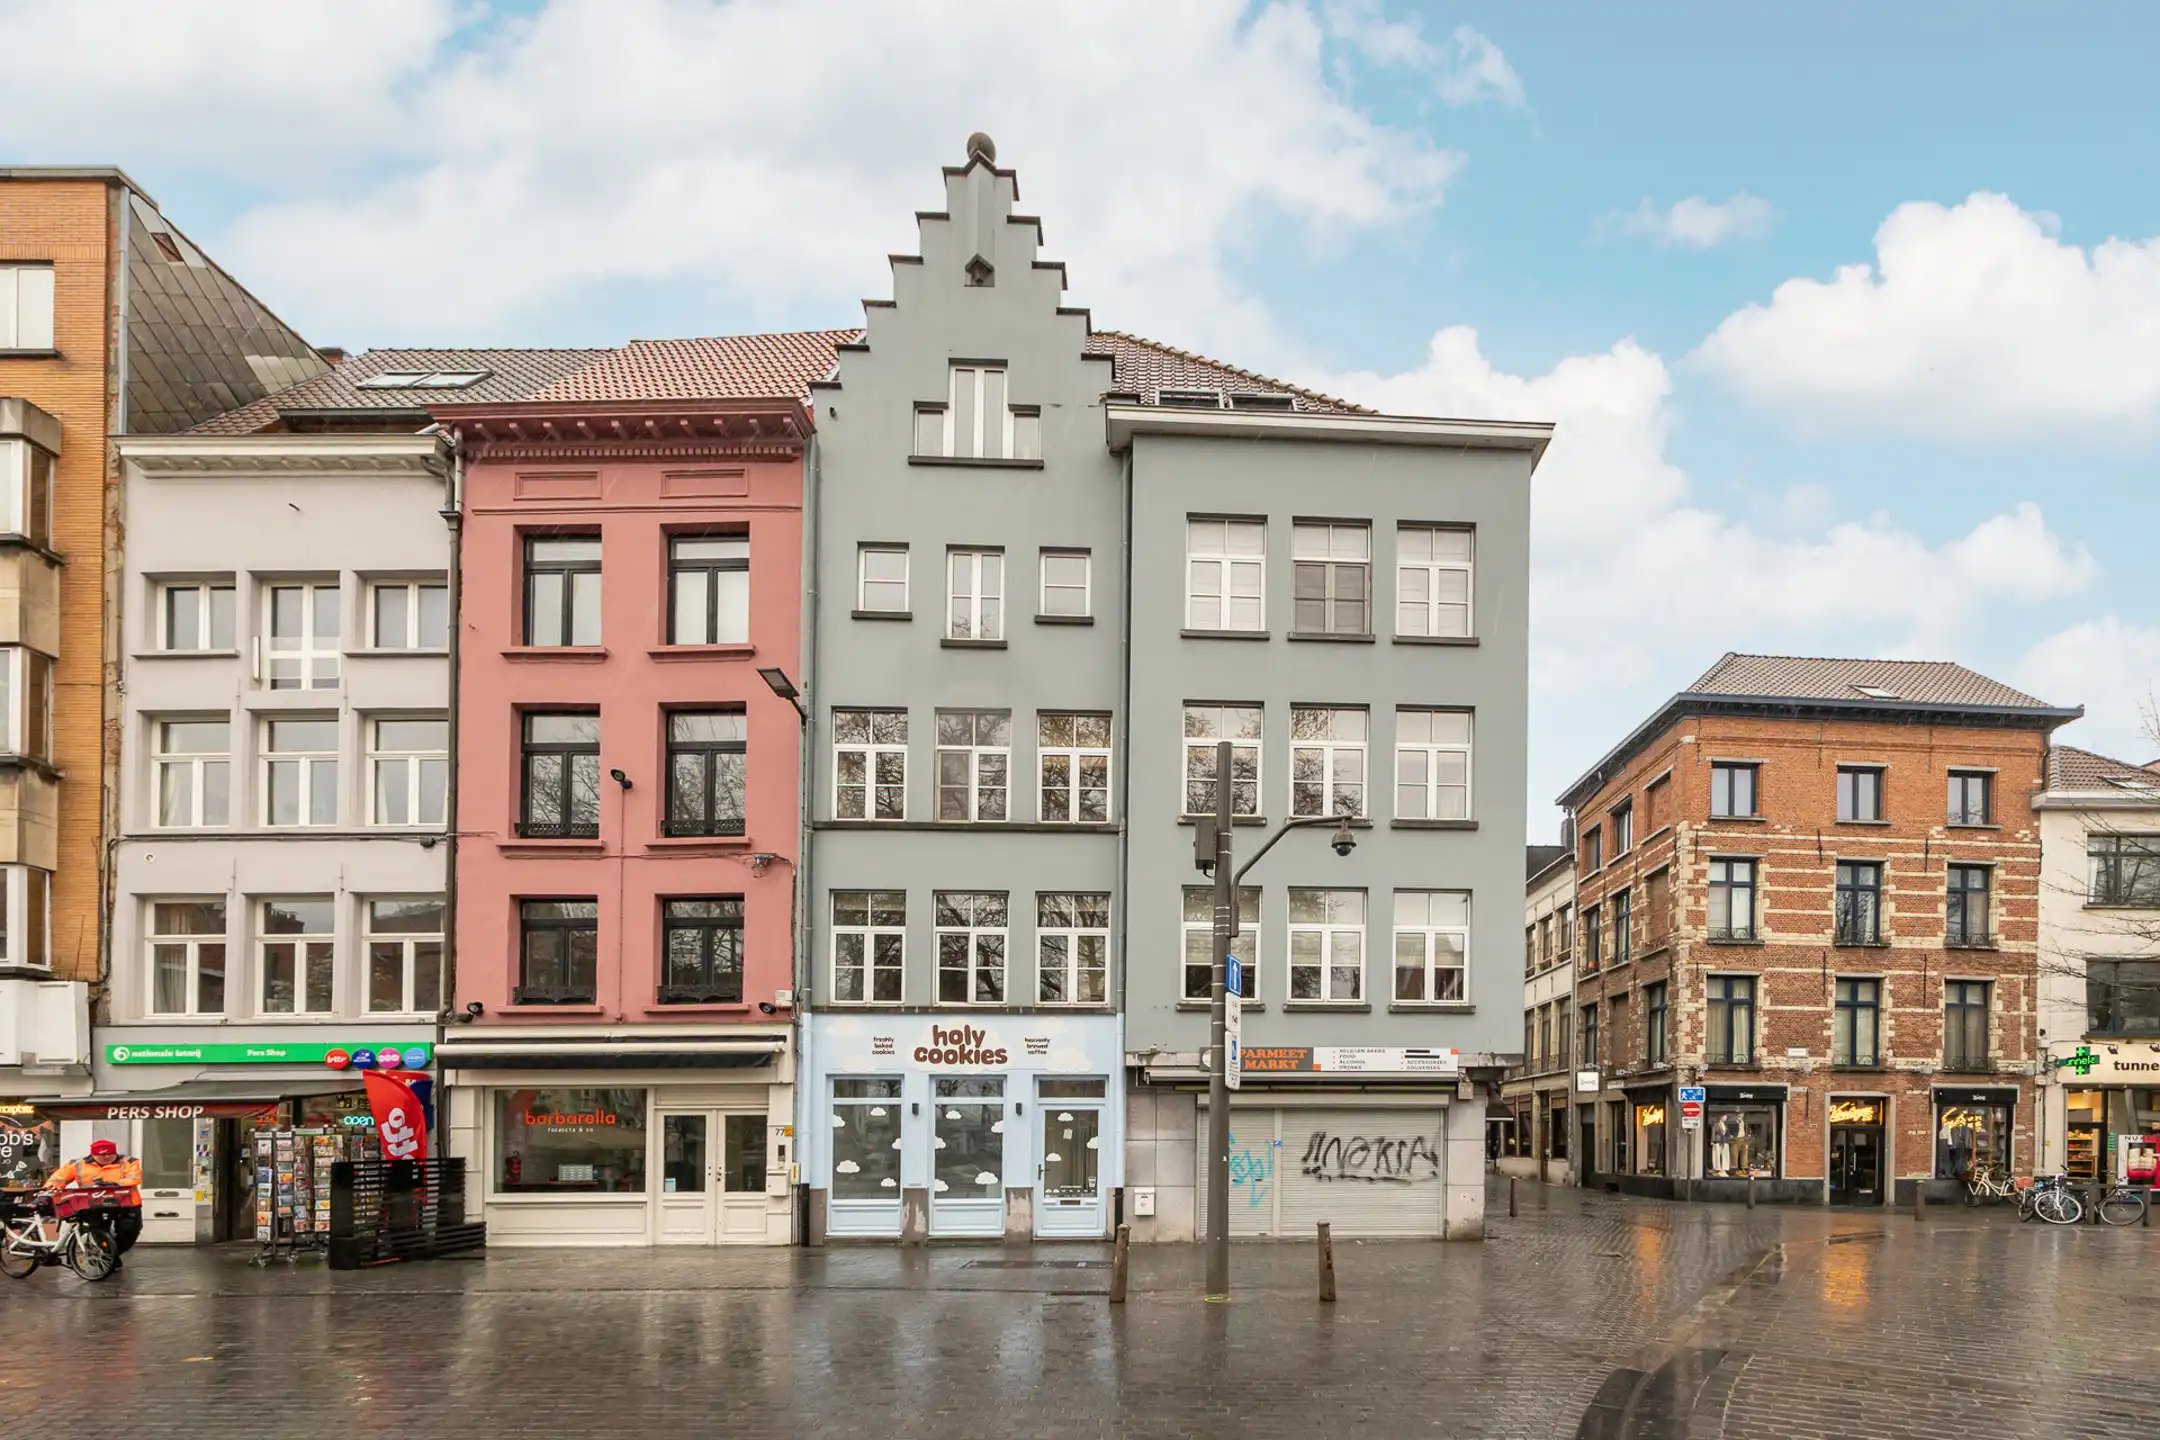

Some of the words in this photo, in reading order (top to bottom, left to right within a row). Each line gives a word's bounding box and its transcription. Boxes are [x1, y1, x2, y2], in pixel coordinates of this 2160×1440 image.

[932, 1024, 985, 1048] holy
[266, 1049, 286, 1057] Shop
[914, 1044, 1008, 1065] cookies
[1245, 1060, 1299, 1069] MARKT
[107, 1106, 150, 1119] PERS
[154, 1105, 204, 1119] SHOP
[525, 1108, 616, 1125] barbarella
[343, 1115, 375, 1126] open
